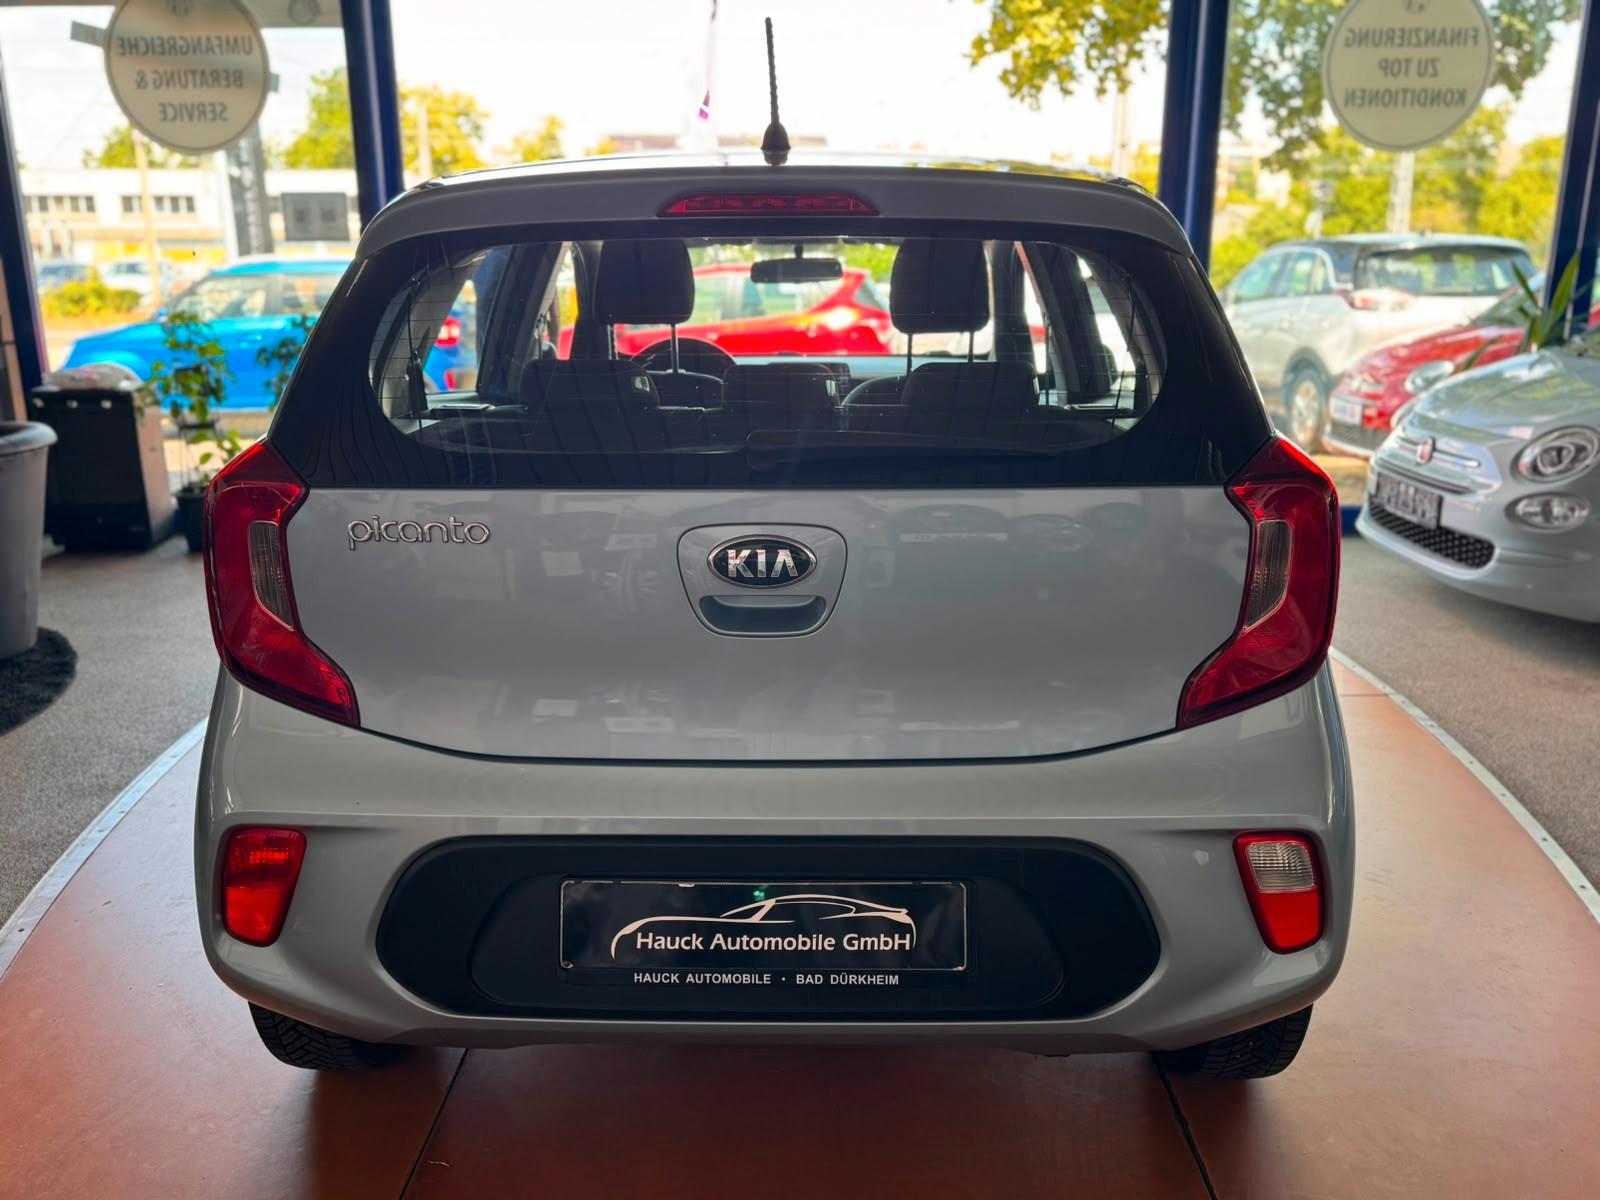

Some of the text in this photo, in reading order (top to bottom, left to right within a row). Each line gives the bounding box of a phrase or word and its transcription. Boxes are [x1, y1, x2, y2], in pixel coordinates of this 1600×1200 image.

[348, 515, 490, 550] picanto
[726, 549, 798, 577] KIA
[636, 932, 910, 951] Hauck Automobile GmbH
[634, 972, 899, 985] HAUCK AUTOMOBILE BAD DÜRKHEIM
